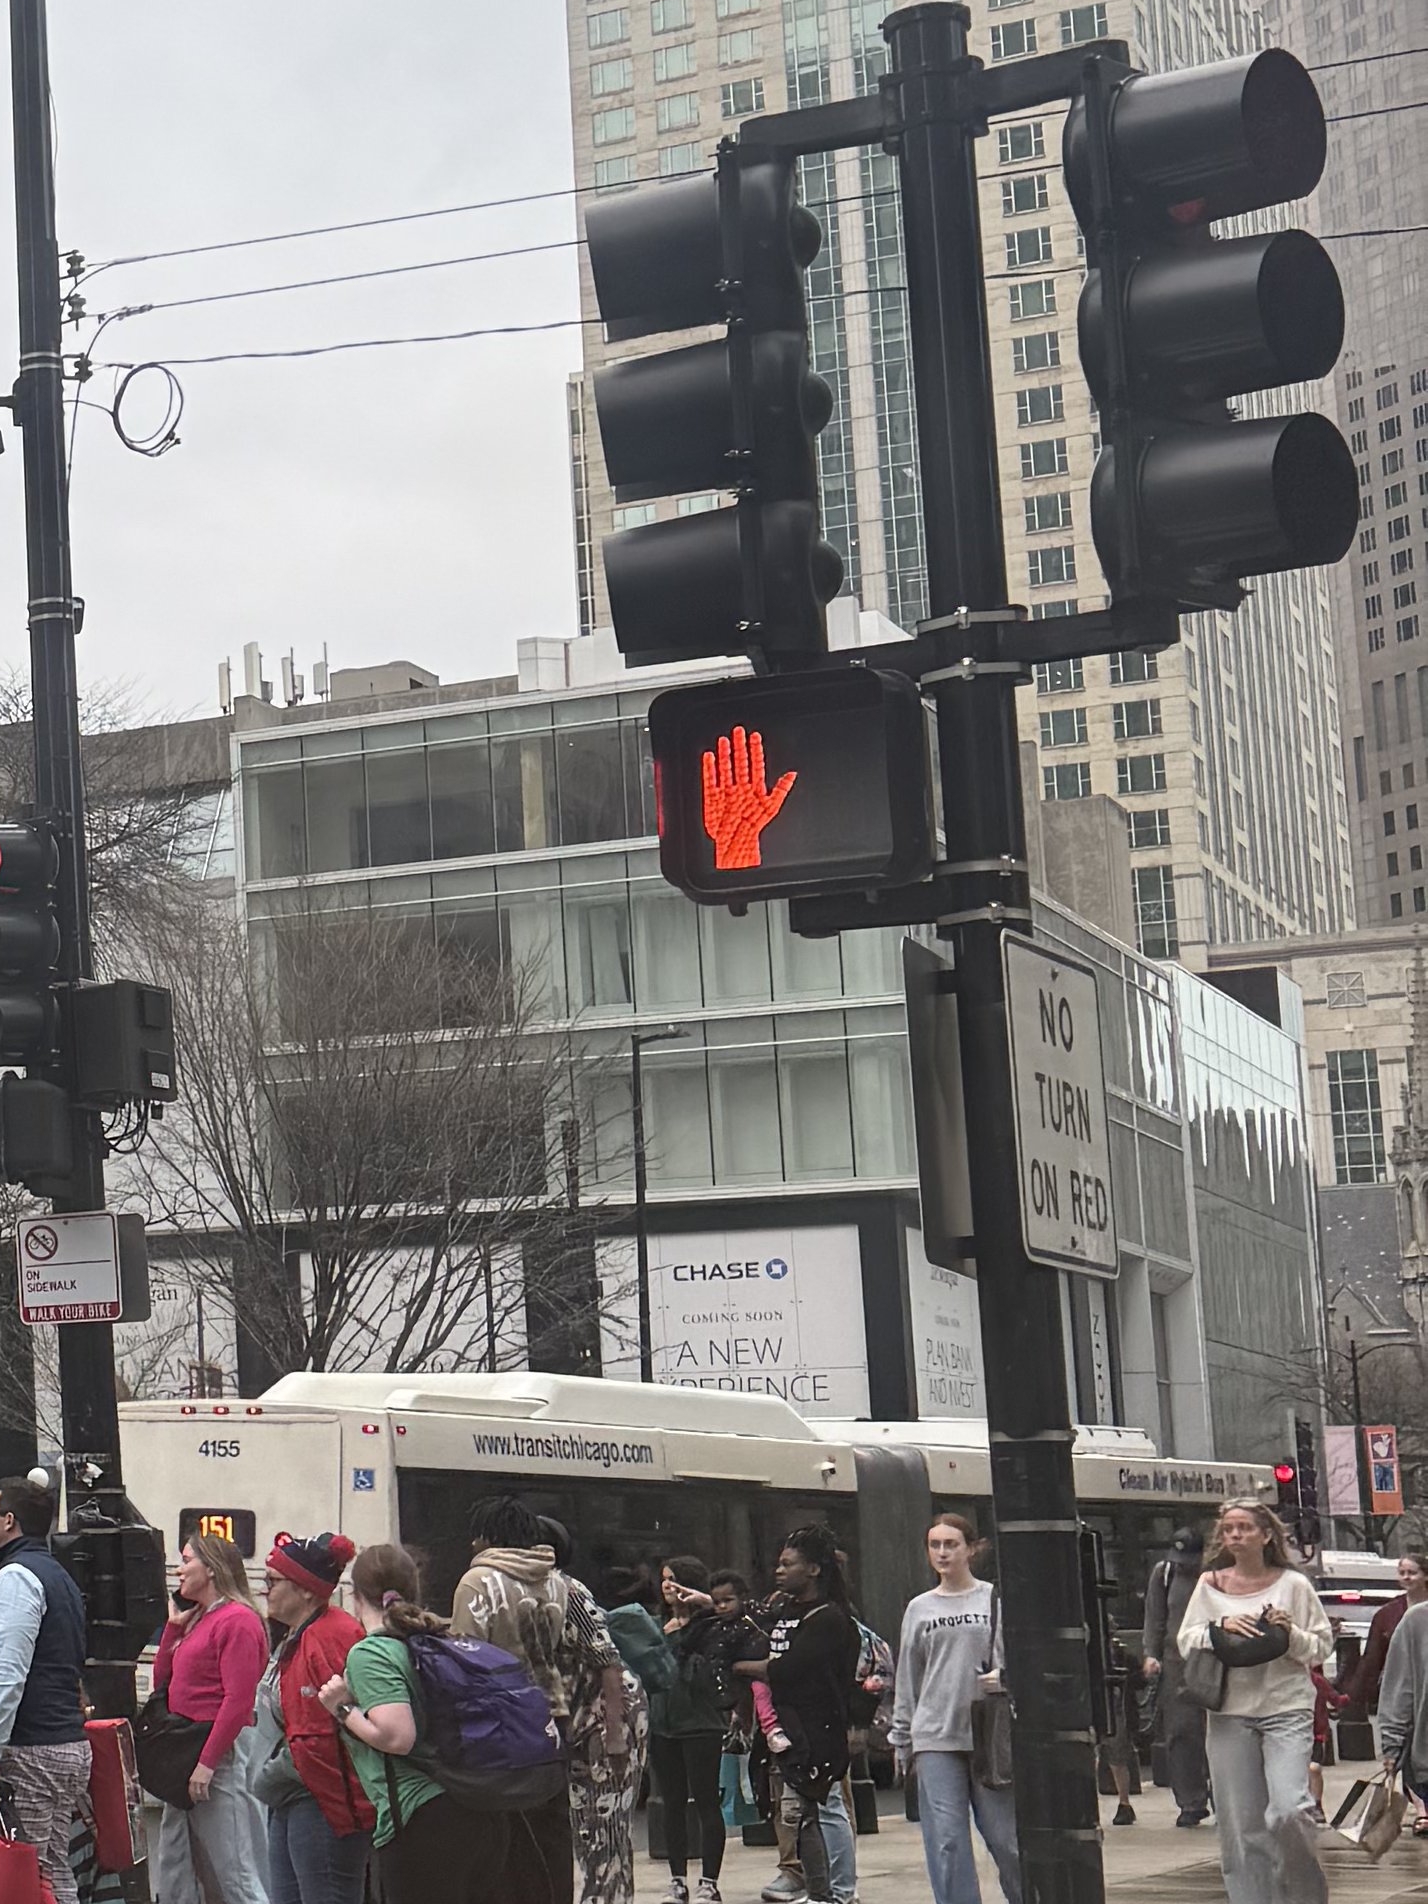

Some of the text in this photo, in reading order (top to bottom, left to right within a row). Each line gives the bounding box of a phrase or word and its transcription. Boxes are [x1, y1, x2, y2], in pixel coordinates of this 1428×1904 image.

[1038, 987, 1074, 1053] NO
[1034, 1071, 1092, 1144] TURN
[1030, 1158, 1109, 1232] ON RED
[26, 1269, 40, 1281] ON
[673, 1261, 761, 1282] CHASE
[27, 1279, 77, 1293] SIDEWALK
[29, 1303, 112, 1322] WALK YOUR BIKE
[682, 1310, 784, 1325] COMING SOON
[676, 1336, 783, 1367] A NEW
[199, 1440, 241, 1457] 4155
[472, 1432, 654, 1468] www.transitchicago.com
[199, 1515, 235, 1543] 151
